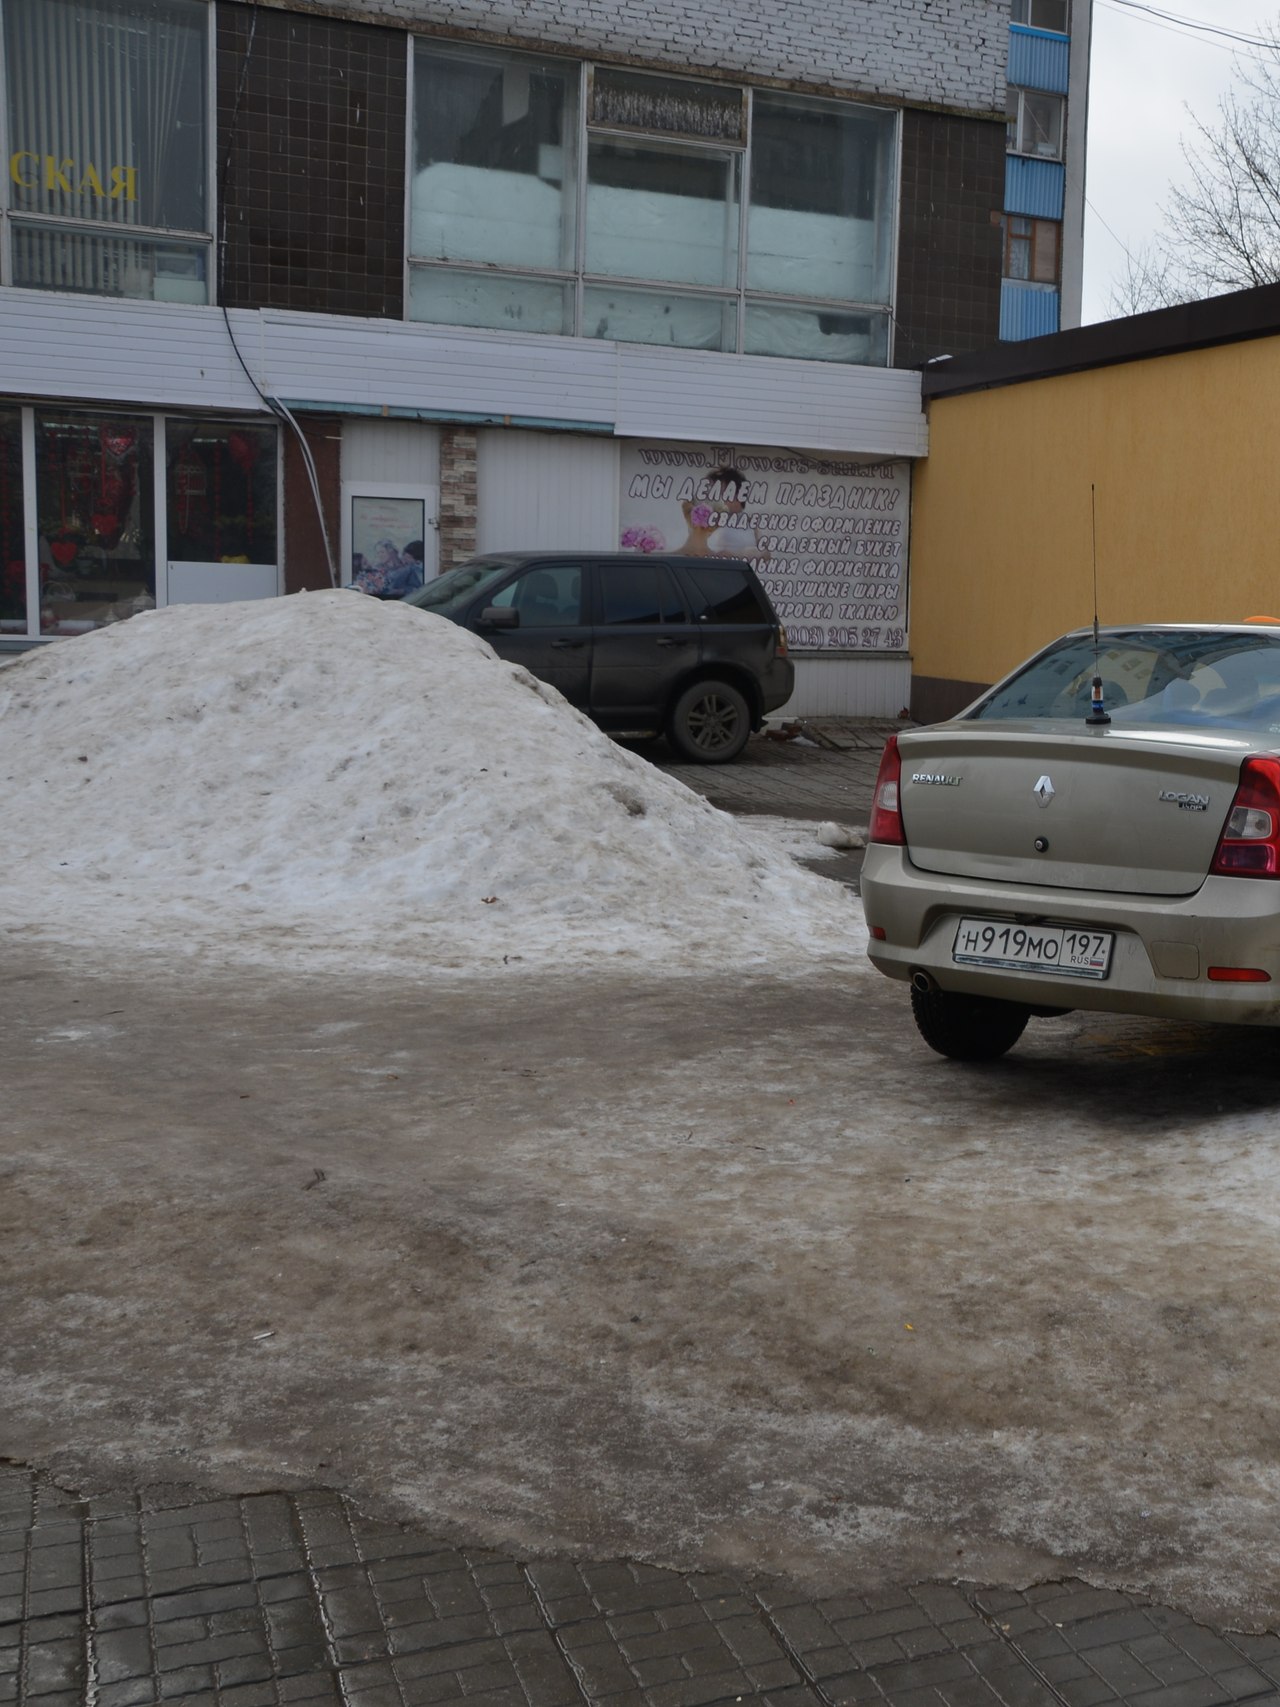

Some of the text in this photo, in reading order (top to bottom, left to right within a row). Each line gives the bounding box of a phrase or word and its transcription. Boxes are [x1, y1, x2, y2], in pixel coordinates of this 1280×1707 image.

[10, 151, 139, 201] СКАЯ
[628, 474, 900, 511] МЫ ДЕЛАЕМ ПРАЗДНИК!
[707, 511, 901, 536] СВАДЕБНОЕ ОФОРМЛЕНИЕ
[757, 535, 902, 558] СВАДЕБНЫЙ БУКЕТ
[803, 559, 900, 579] ФЛОРИСТИКА
[853, 583, 899, 600] ШАРЫ
[772, 601, 899, 620] ИРОВКА ТКАНЬЮ
[828, 626, 858, 648] 205
[862, 627, 881, 648] 27
[885, 628, 904, 648] 43
[912, 773, 962, 786] RENAULT
[1159, 790, 1211, 805] LOGAN
[1066, 934, 1105, 956] 197
[1070, 955, 1089, 965] RUS
